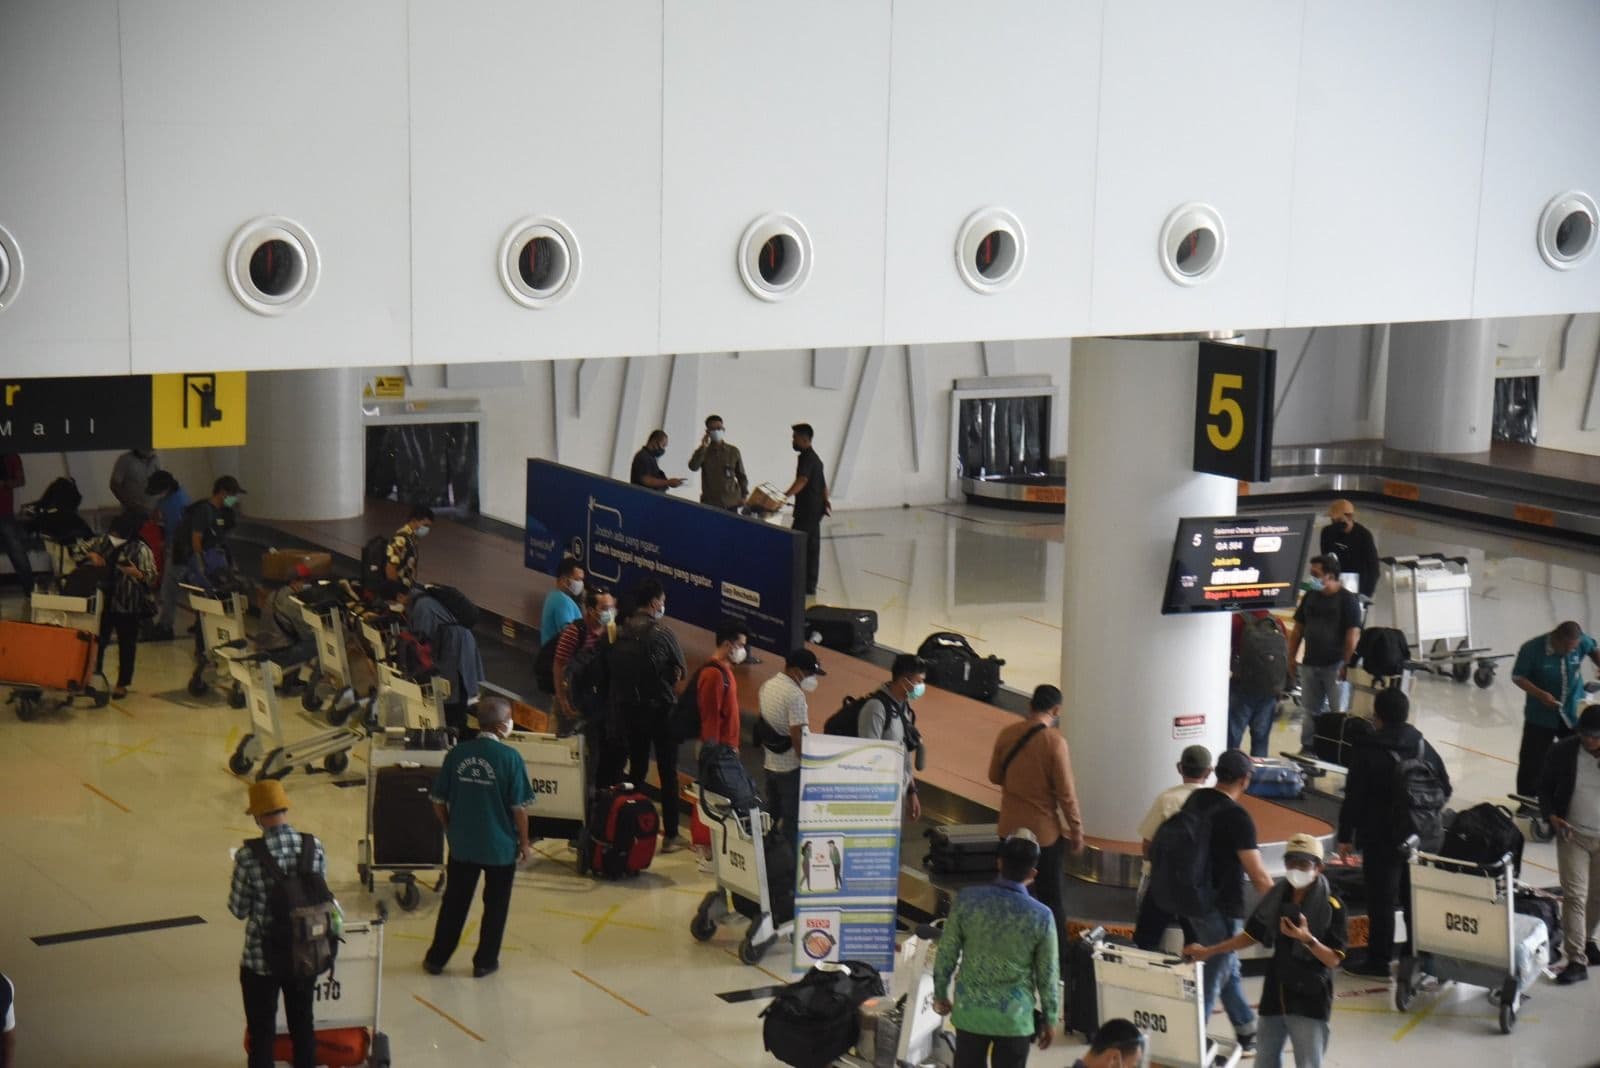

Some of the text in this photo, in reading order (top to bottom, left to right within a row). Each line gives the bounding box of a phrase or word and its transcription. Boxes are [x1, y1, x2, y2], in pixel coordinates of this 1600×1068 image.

[1206, 372, 1244, 451] 5
[0, 418, 95, 436] Mall
[1192, 533, 1203, 547] 5
[1212, 557, 1241, 567] Jakarta
[533, 778, 558, 795] 0267
[806, 919, 830, 929] STOP
[1445, 912, 1479, 935] 0263
[1134, 1010, 1168, 1033] 0930
